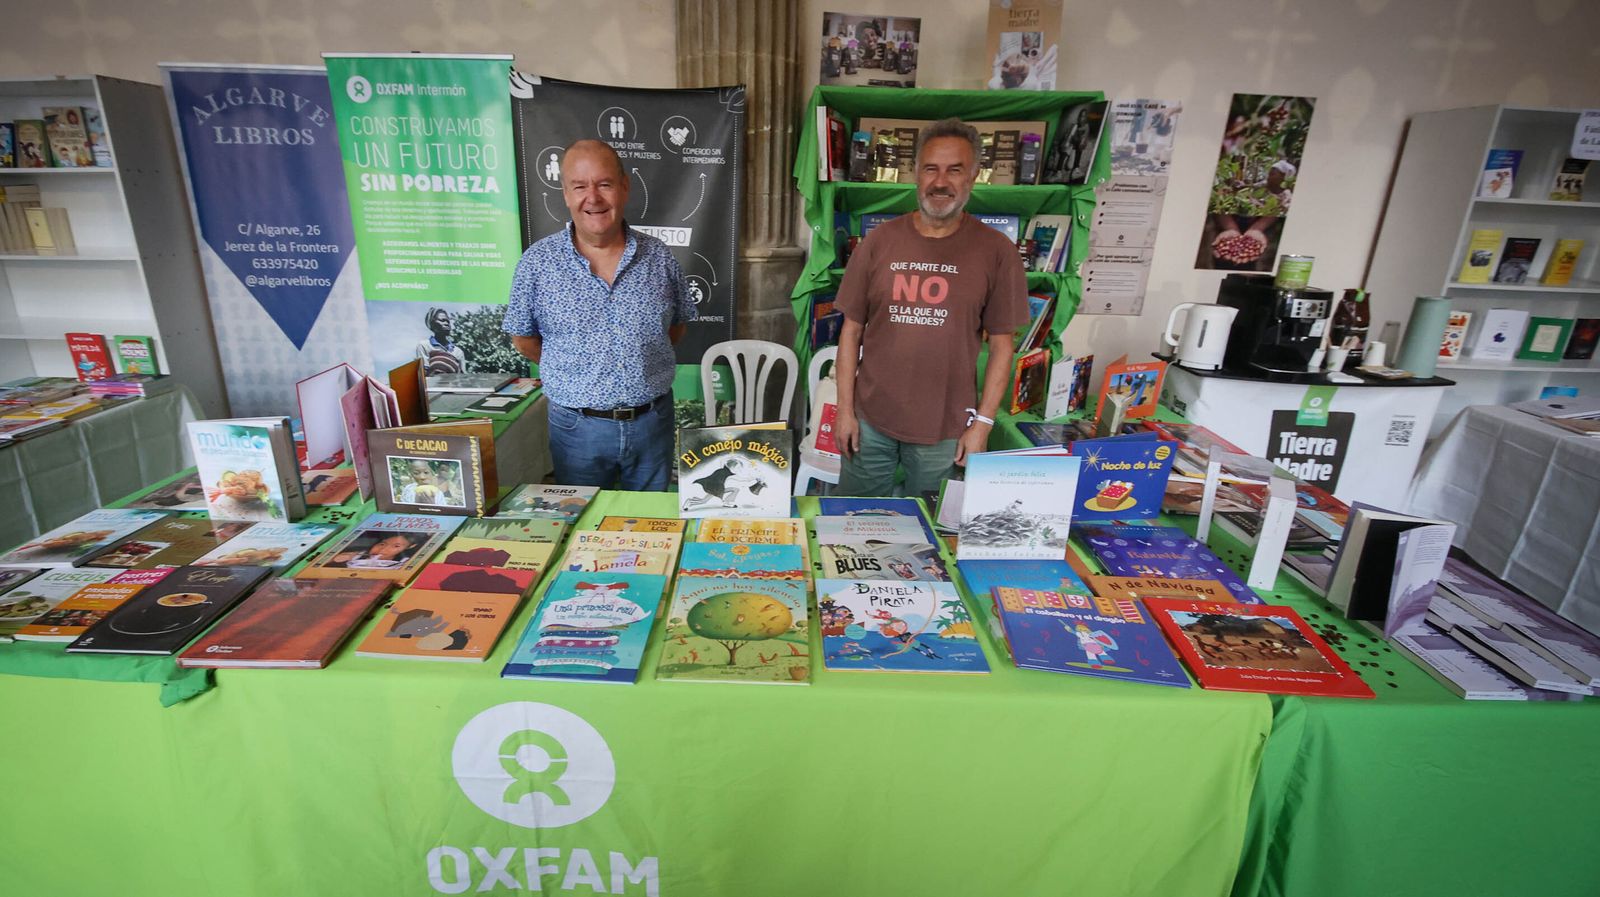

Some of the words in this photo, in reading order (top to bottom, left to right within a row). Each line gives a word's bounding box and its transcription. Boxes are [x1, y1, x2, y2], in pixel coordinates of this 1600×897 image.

[376, 83, 414, 96] OXFAM
[417, 83, 466, 97] Intermón
[192, 87, 330, 128] ALGARVE
[351, 116, 496, 137] CONSTRUYAMOS
[213, 126, 316, 146] LIBROS
[627, 142, 646, 150] ENTRE
[682, 147, 711, 156] COMERCIO
[354, 142, 390, 168] UN
[399, 142, 499, 170] FUTURO
[634, 151, 662, 160] MUJERES
[360, 173, 397, 192] SIN
[402, 174, 500, 193] POBREZA
[238, 223, 251, 237] C/
[255, 224, 304, 237] Algarve,
[306, 225, 321, 236] 26
[224, 241, 256, 252] Jerez
[258, 241, 273, 252] de
[276, 242, 287, 252] la
[290, 242, 339, 253] Frontera
[252, 259, 319, 270] 633975420
[890, 261, 907, 272] QUE
[909, 262, 939, 273] PARTE
[940, 264, 959, 274] DEL
[245, 275, 331, 288] @algarvelibros
[892, 273, 949, 304] NO
[889, 305, 899, 313] ES
[900, 306, 912, 315] LA
[914, 306, 932, 316] QUE
[933, 308, 948, 318] NO
[890, 314, 945, 327] ENTIENDES?
[396, 438, 404, 449] C
[404, 440, 416, 450] DE
[416, 439, 449, 452] CACAO
[1279, 431, 1338, 456] Tierra
[681, 450, 701, 469] El
[702, 438, 743, 455] conejo
[747, 441, 789, 469] mágico
[1101, 461, 1131, 471] Noche
[1133, 461, 1146, 470] de
[1147, 461, 1163, 470] luz
[1273, 457, 1334, 481] Madre
[731, 536, 780, 544] DUERME
[593, 554, 647, 573] Jamela
[835, 558, 882, 575] BLUES
[117, 570, 168, 580] postres
[851, 583, 923, 596] DANIELA
[1109, 582, 1122, 591] N
[1127, 580, 1143, 588] de
[1150, 580, 1216, 596] Navidad
[733, 583, 753, 591] hay
[761, 586, 801, 608] silencio
[870, 596, 916, 607] PIRATA
[554, 604, 573, 613] Una
[575, 603, 615, 614] princesa
[616, 606, 638, 616] real
[1035, 609, 1075, 619] caballero
[1094, 615, 1126, 624] dragón
[426, 846, 660, 897] OXFAM
